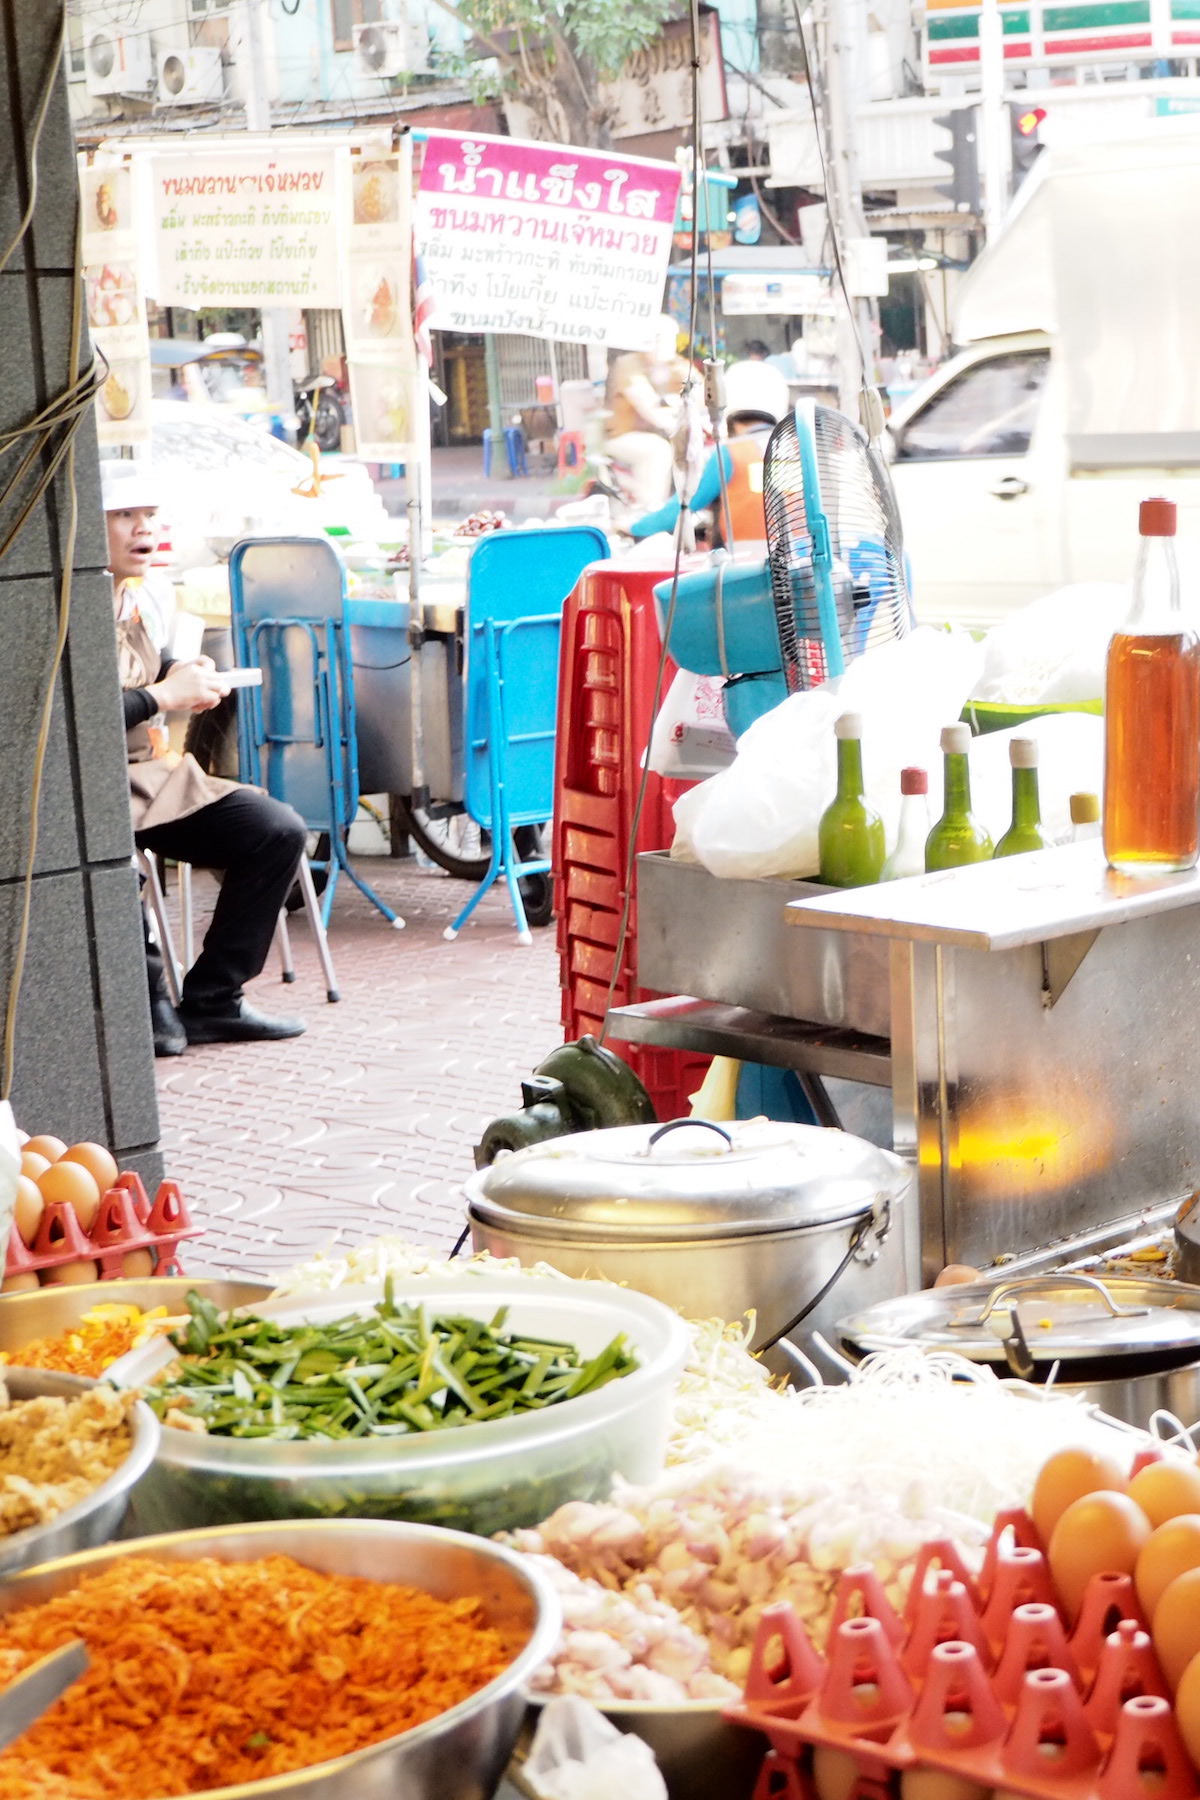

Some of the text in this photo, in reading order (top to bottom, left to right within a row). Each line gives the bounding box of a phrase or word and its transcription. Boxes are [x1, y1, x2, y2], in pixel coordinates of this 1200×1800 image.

[438, 141, 661, 219] น้ำแข็งใส
[429, 205, 659, 257] ขนมหวานเจ๊หมวย
[460, 243, 561, 272] มะพร้าวกะทิ
[568, 253, 660, 285] ทับทิมกรอบ
[450, 307, 607, 341] ขนมปังน้ำแดง
